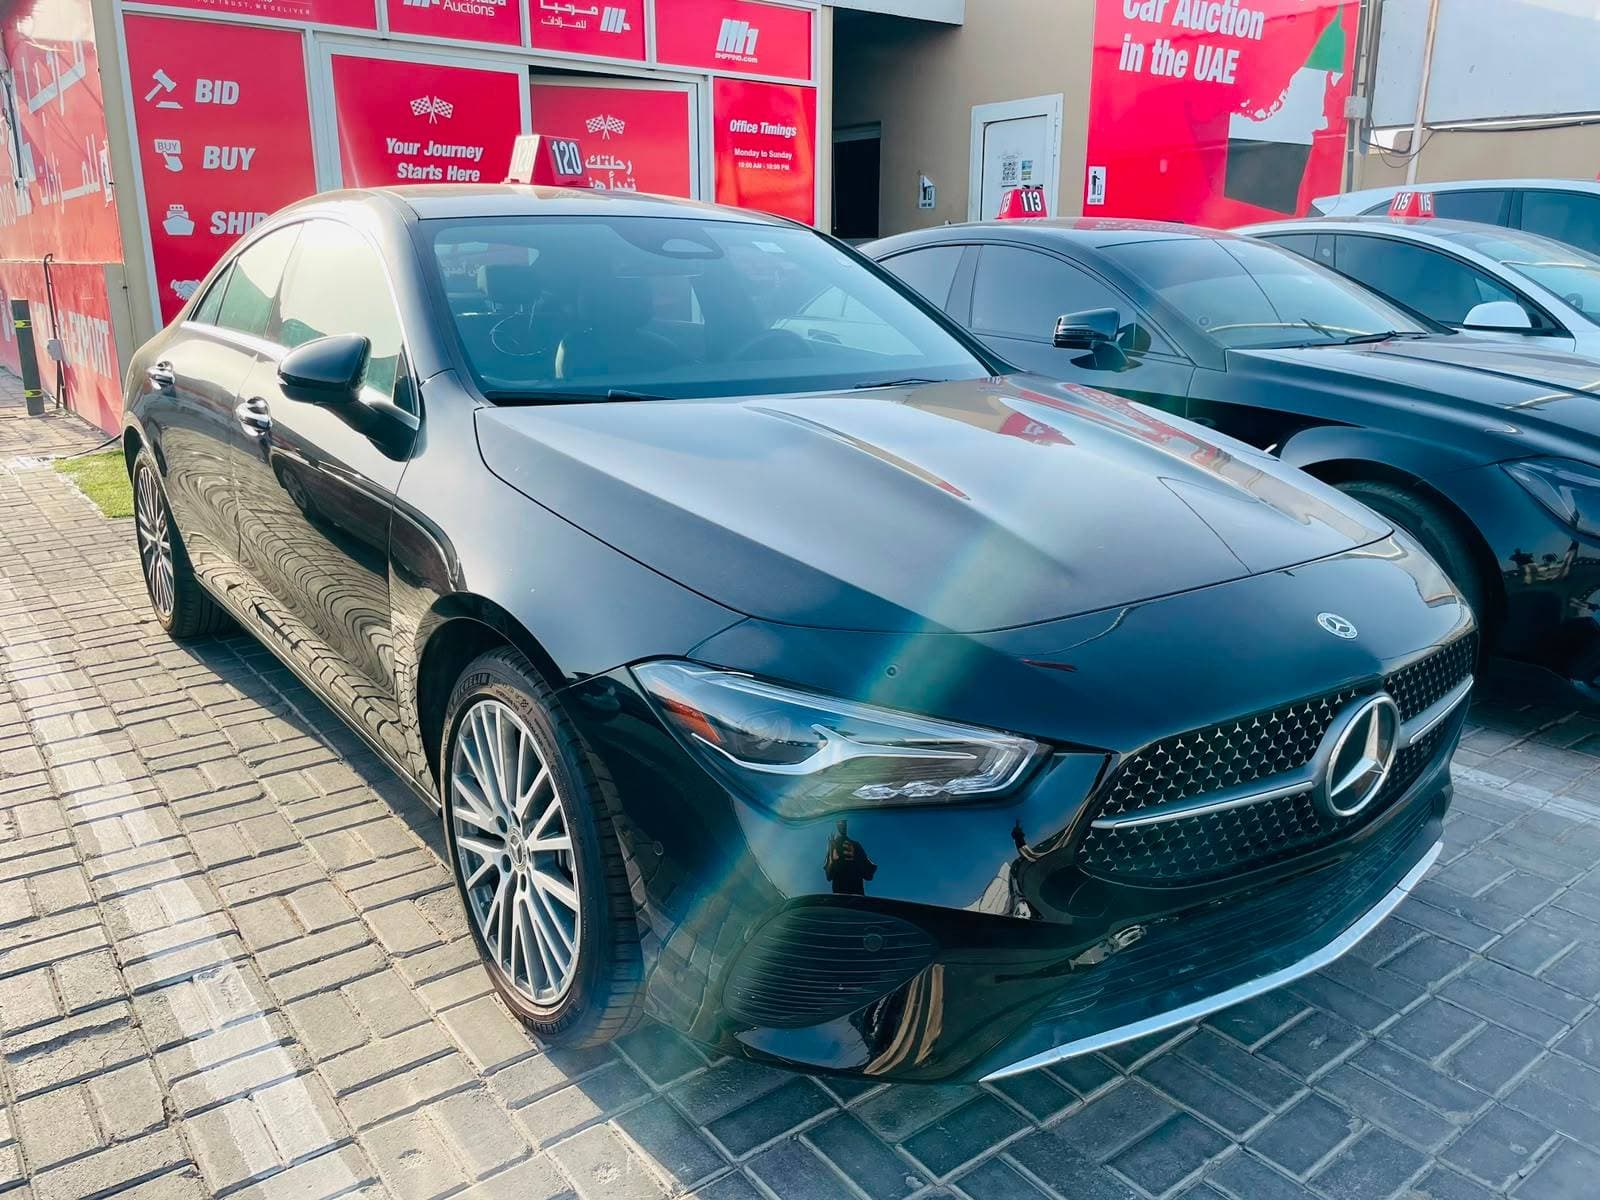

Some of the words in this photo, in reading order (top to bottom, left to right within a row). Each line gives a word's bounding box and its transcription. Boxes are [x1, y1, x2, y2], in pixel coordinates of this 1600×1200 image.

[443, 0, 495, 17] Auctions
[1122, 0, 1169, 23] Car
[1171, 0, 1265, 40] Auction
[1119, 33, 1145, 73] in
[1150, 39, 1189, 78] the
[1193, 44, 1240, 85] UAE
[195, 78, 240, 105] BID
[729, 119, 759, 134] Office
[760, 122, 797, 139] Timings
[157, 141, 178, 151] BUY
[386, 137, 421, 155] Your
[423, 140, 483, 162] Journey
[734, 147, 760, 158] Monday
[769, 150, 793, 160] Sunday
[202, 145, 256, 171] BUY
[552, 140, 583, 175] 120
[585, 154, 633, 175] رحلتك
[397, 162, 443, 180] Starts
[446, 165, 481, 182] Here
[1021, 191, 1042, 212] 113
[1393, 193, 1411, 210] 115
[1420, 193, 1431, 212] 115
